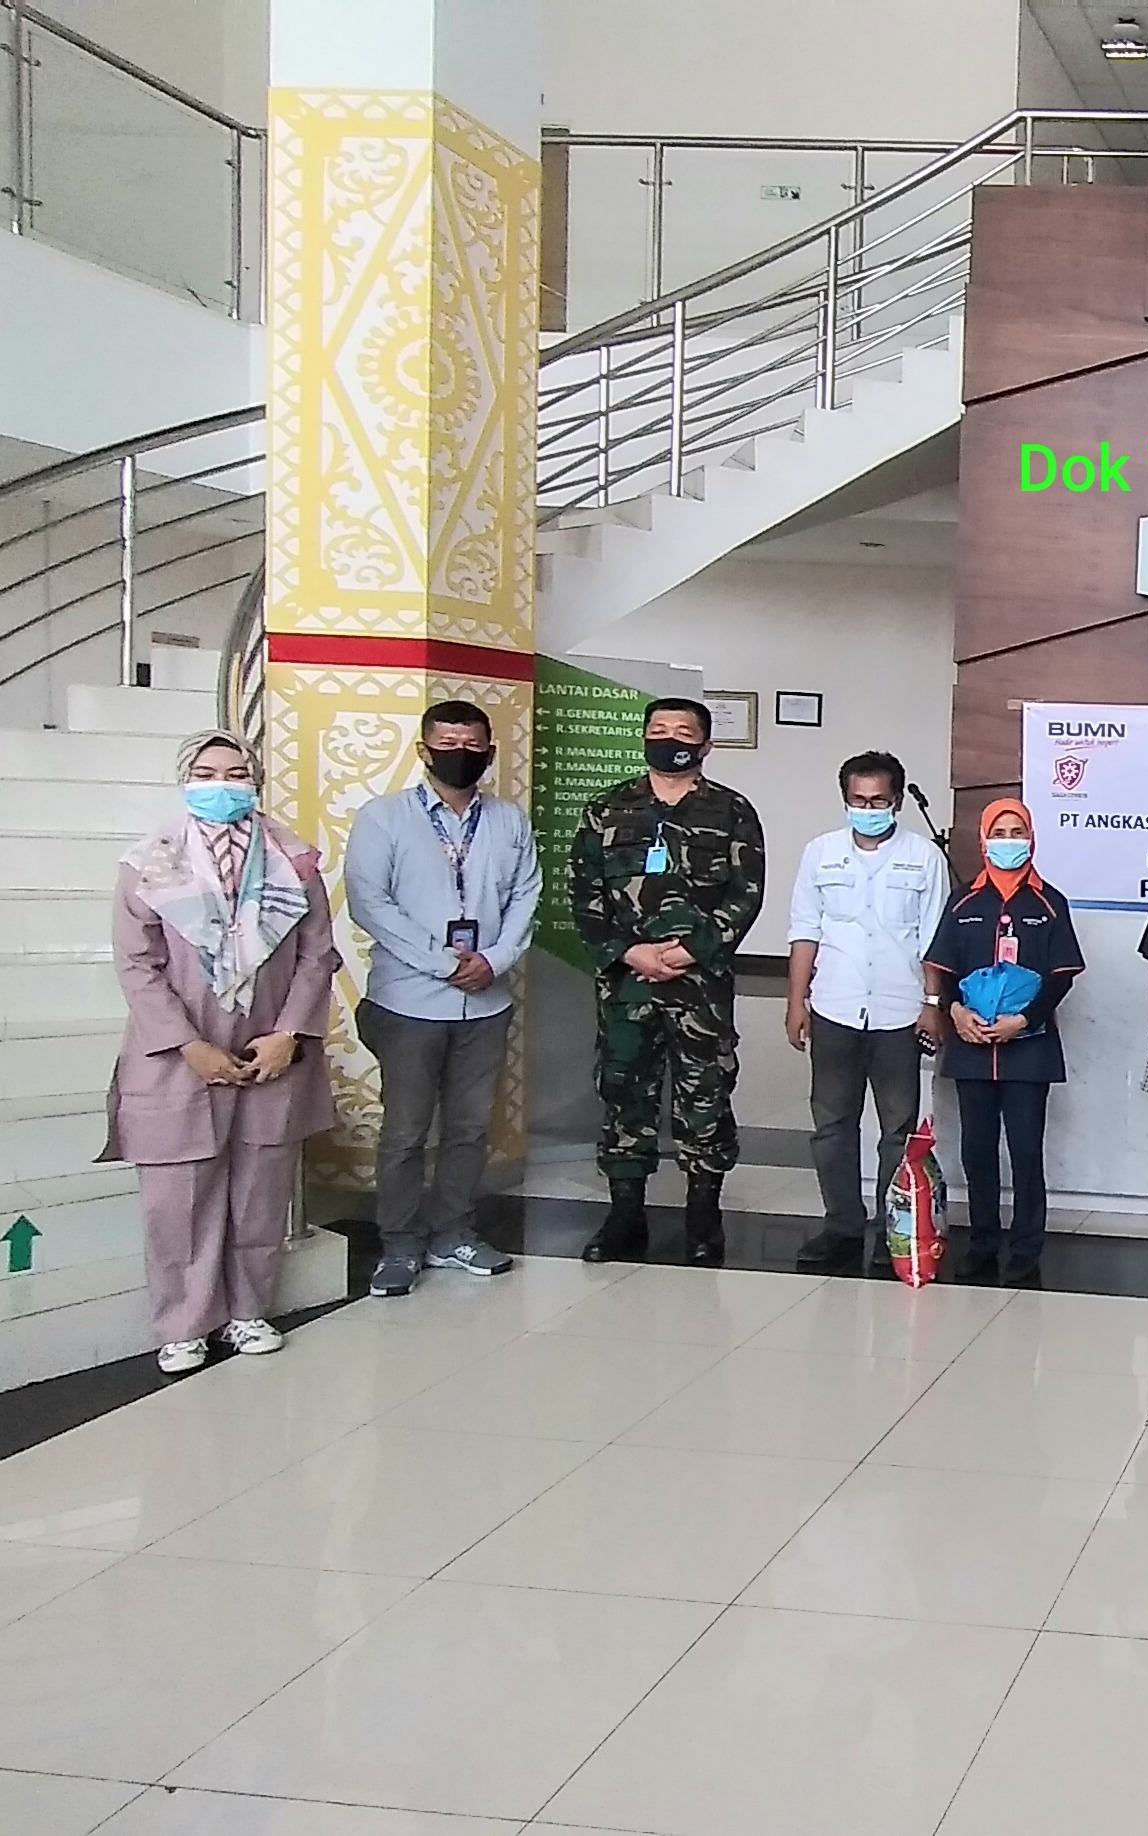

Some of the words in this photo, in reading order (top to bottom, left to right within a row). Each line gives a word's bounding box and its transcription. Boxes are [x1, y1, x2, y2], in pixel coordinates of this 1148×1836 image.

[539, 684, 588, 697] LANTAI
[592, 686, 639, 700] DASAR
[556, 724, 631, 738] R.SEKRETARIS
[1048, 722, 1126, 738] BUMN
[625, 750, 646, 761] TEK
[624, 764, 650, 775] OPE
[1060, 813, 1079, 828] PT
